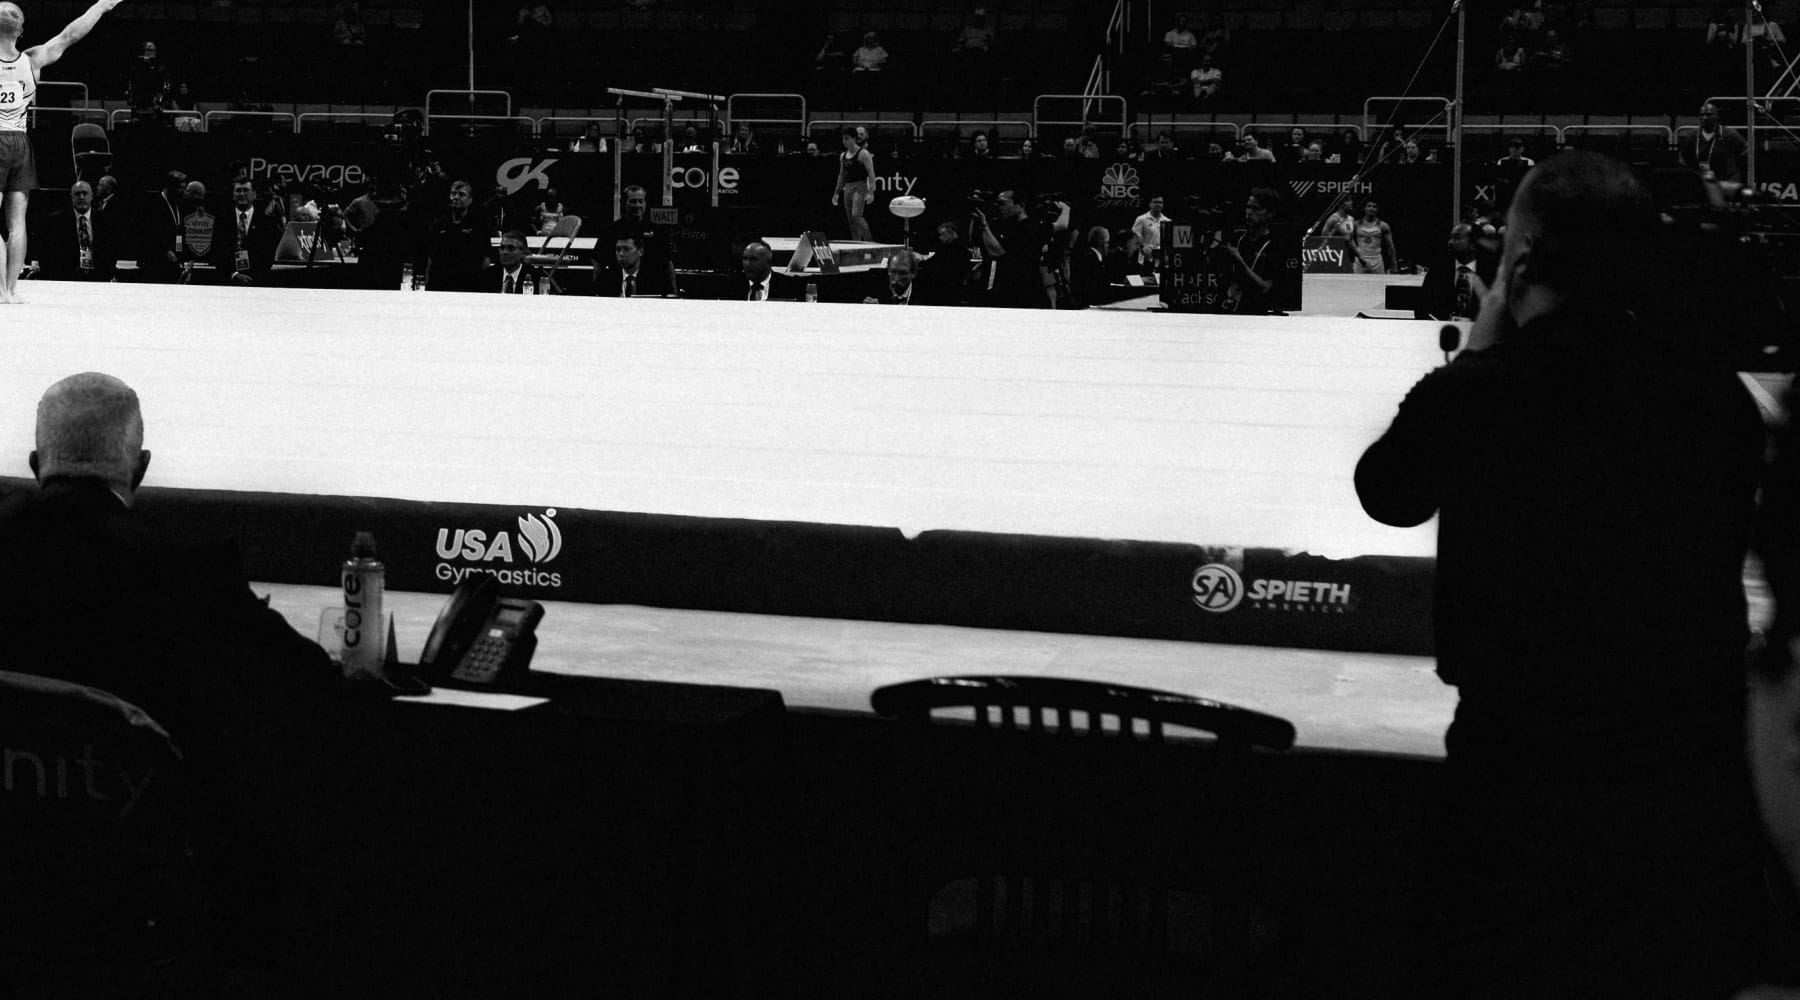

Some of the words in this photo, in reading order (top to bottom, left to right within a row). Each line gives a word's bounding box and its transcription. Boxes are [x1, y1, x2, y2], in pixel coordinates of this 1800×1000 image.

[0, 91, 16, 104] 23
[250, 156, 368, 190] Prevage
[1100, 183, 1140, 199] NBC
[1317, 179, 1373, 196] SPIETH
[1173, 253, 1183, 268] 6
[435, 527, 514, 563] USA
[1247, 578, 1351, 604] SPIETH
[344, 573, 362, 648] core
